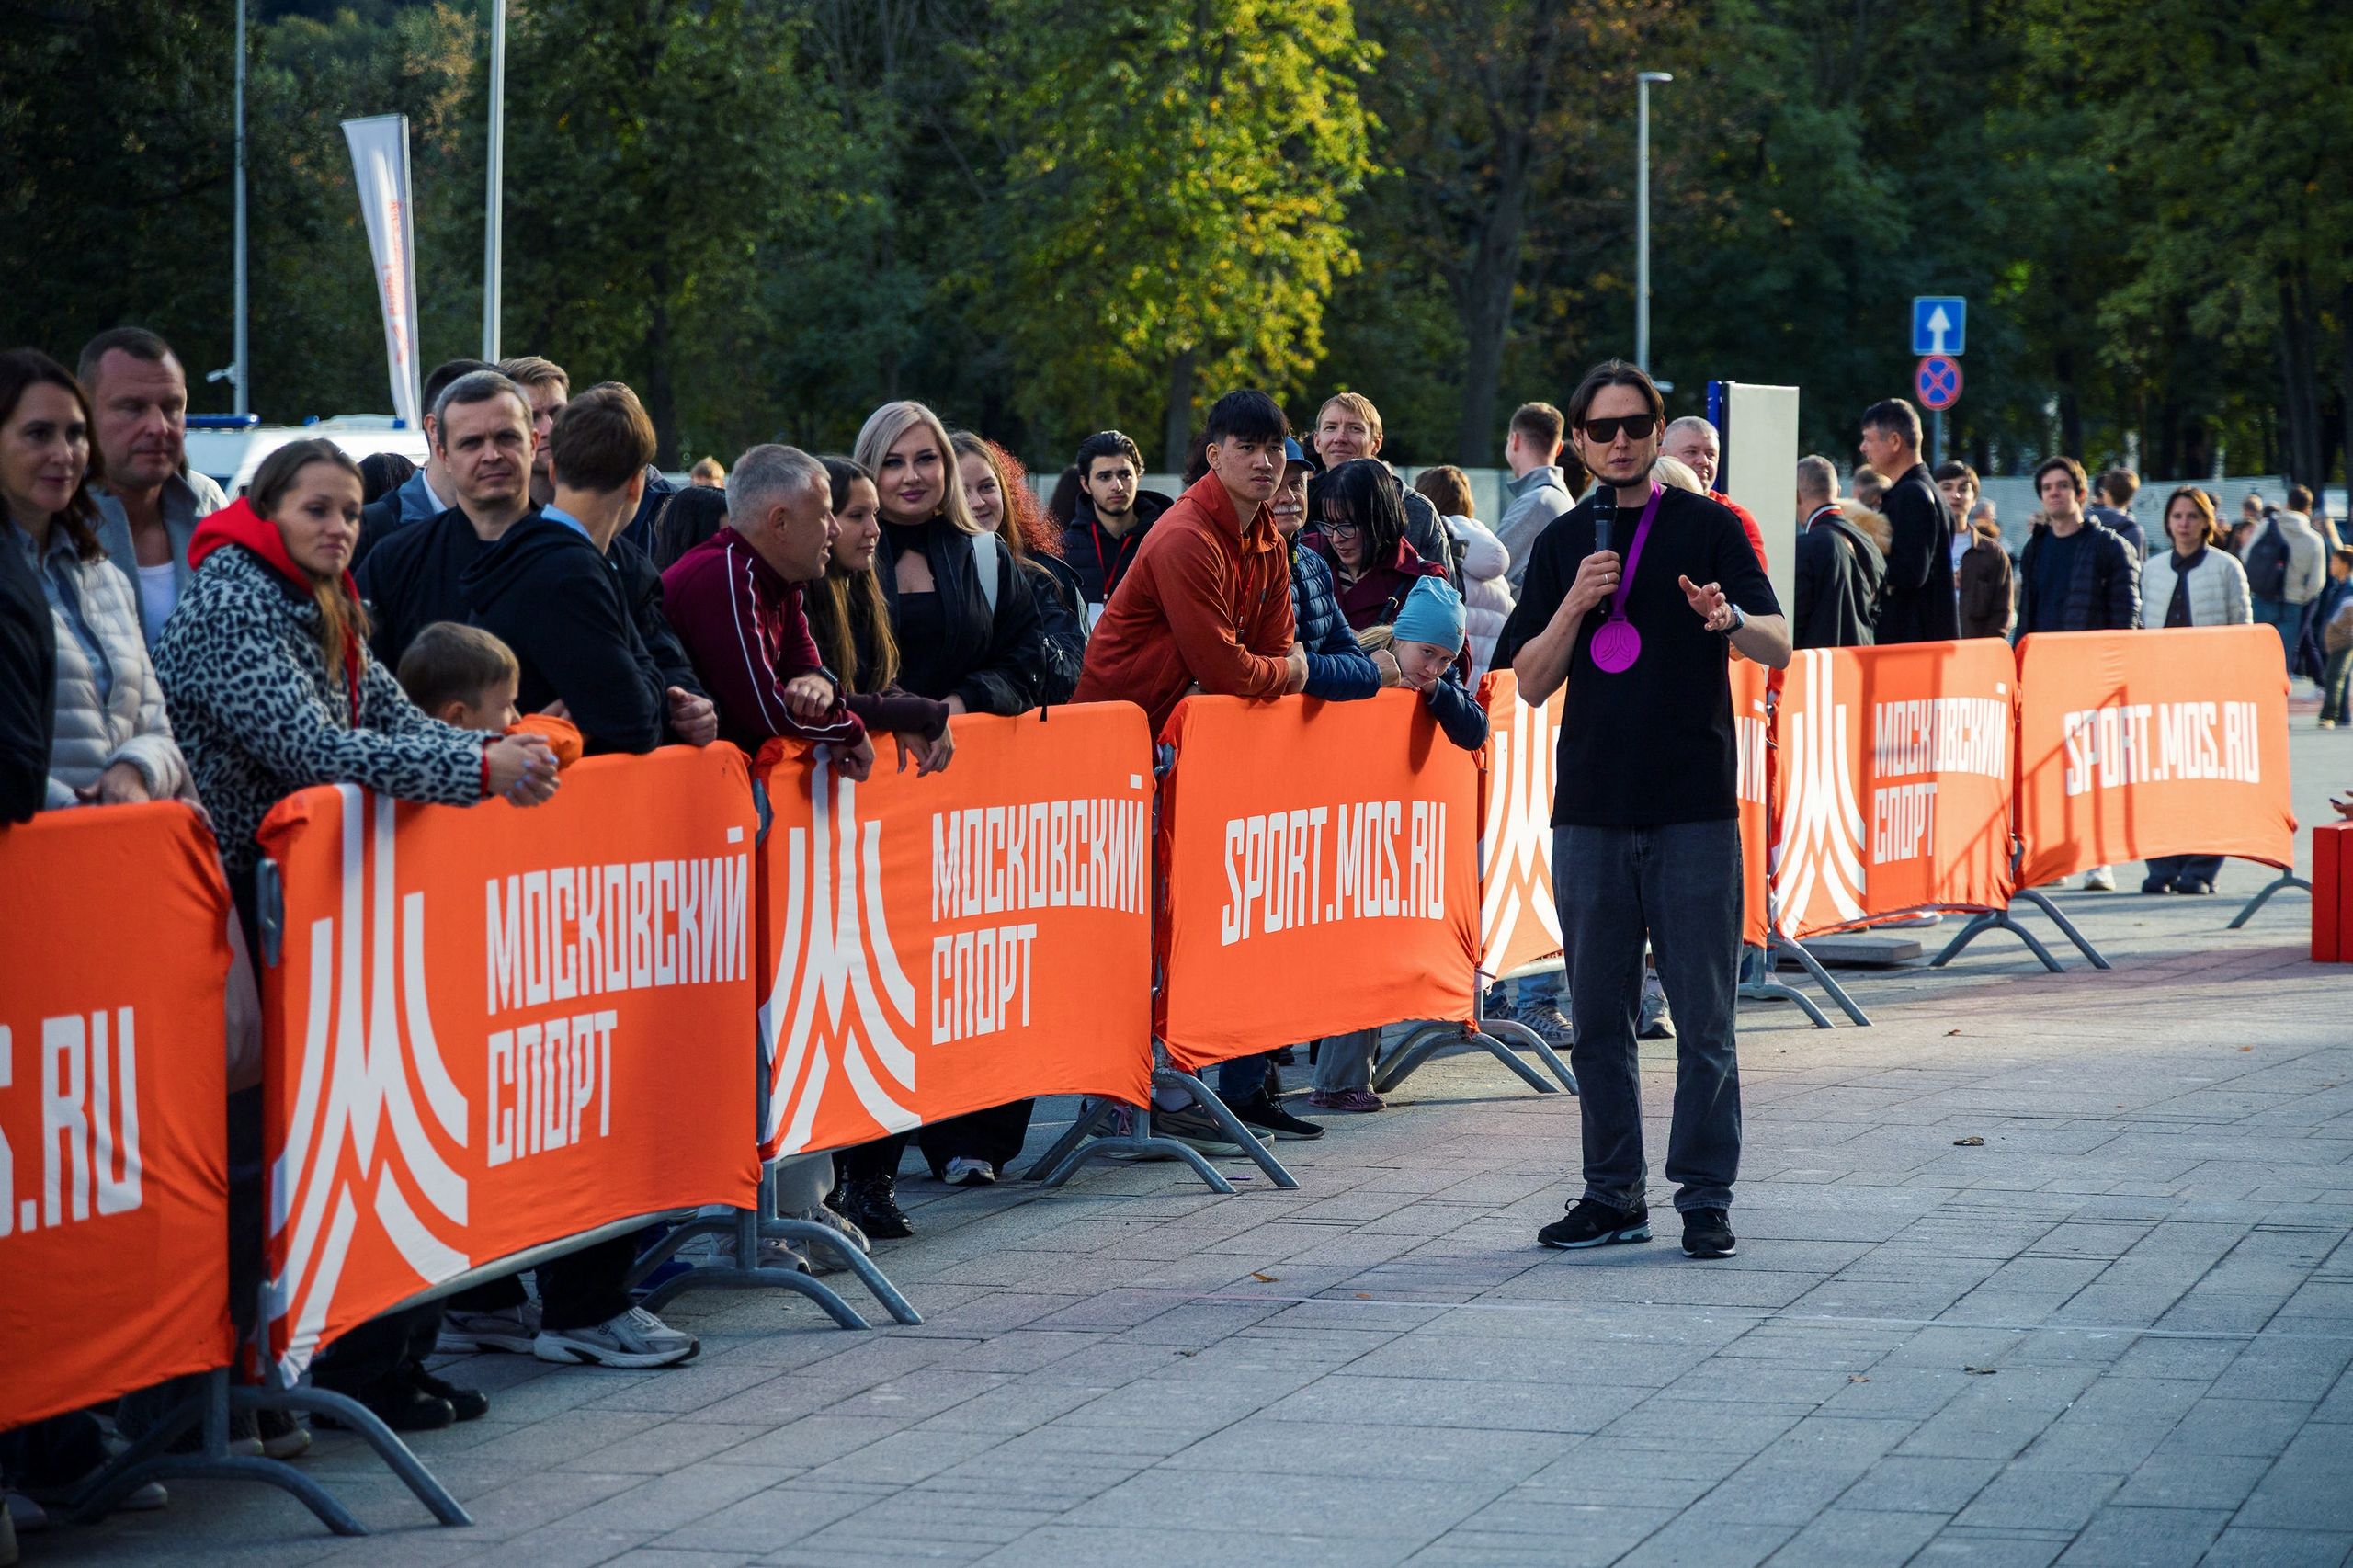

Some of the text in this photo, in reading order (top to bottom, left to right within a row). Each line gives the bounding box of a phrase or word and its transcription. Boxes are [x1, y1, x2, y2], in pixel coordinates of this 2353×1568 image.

[1874, 681, 2007, 780] МОСКОВСКИЙ
[2063, 700, 2261, 797] SPORT.MOS.RU
[931, 774, 1144, 922] МОСКОВСКИЙ
[1221, 801, 1447, 947] SPORT.MOS.RU
[1873, 782, 1938, 865] СПОРТ
[486, 825, 748, 1016] МОСКОВСКИЙ
[931, 923, 1038, 1045] СПОРТ
[487, 1009, 618, 1167] СПОРТ
